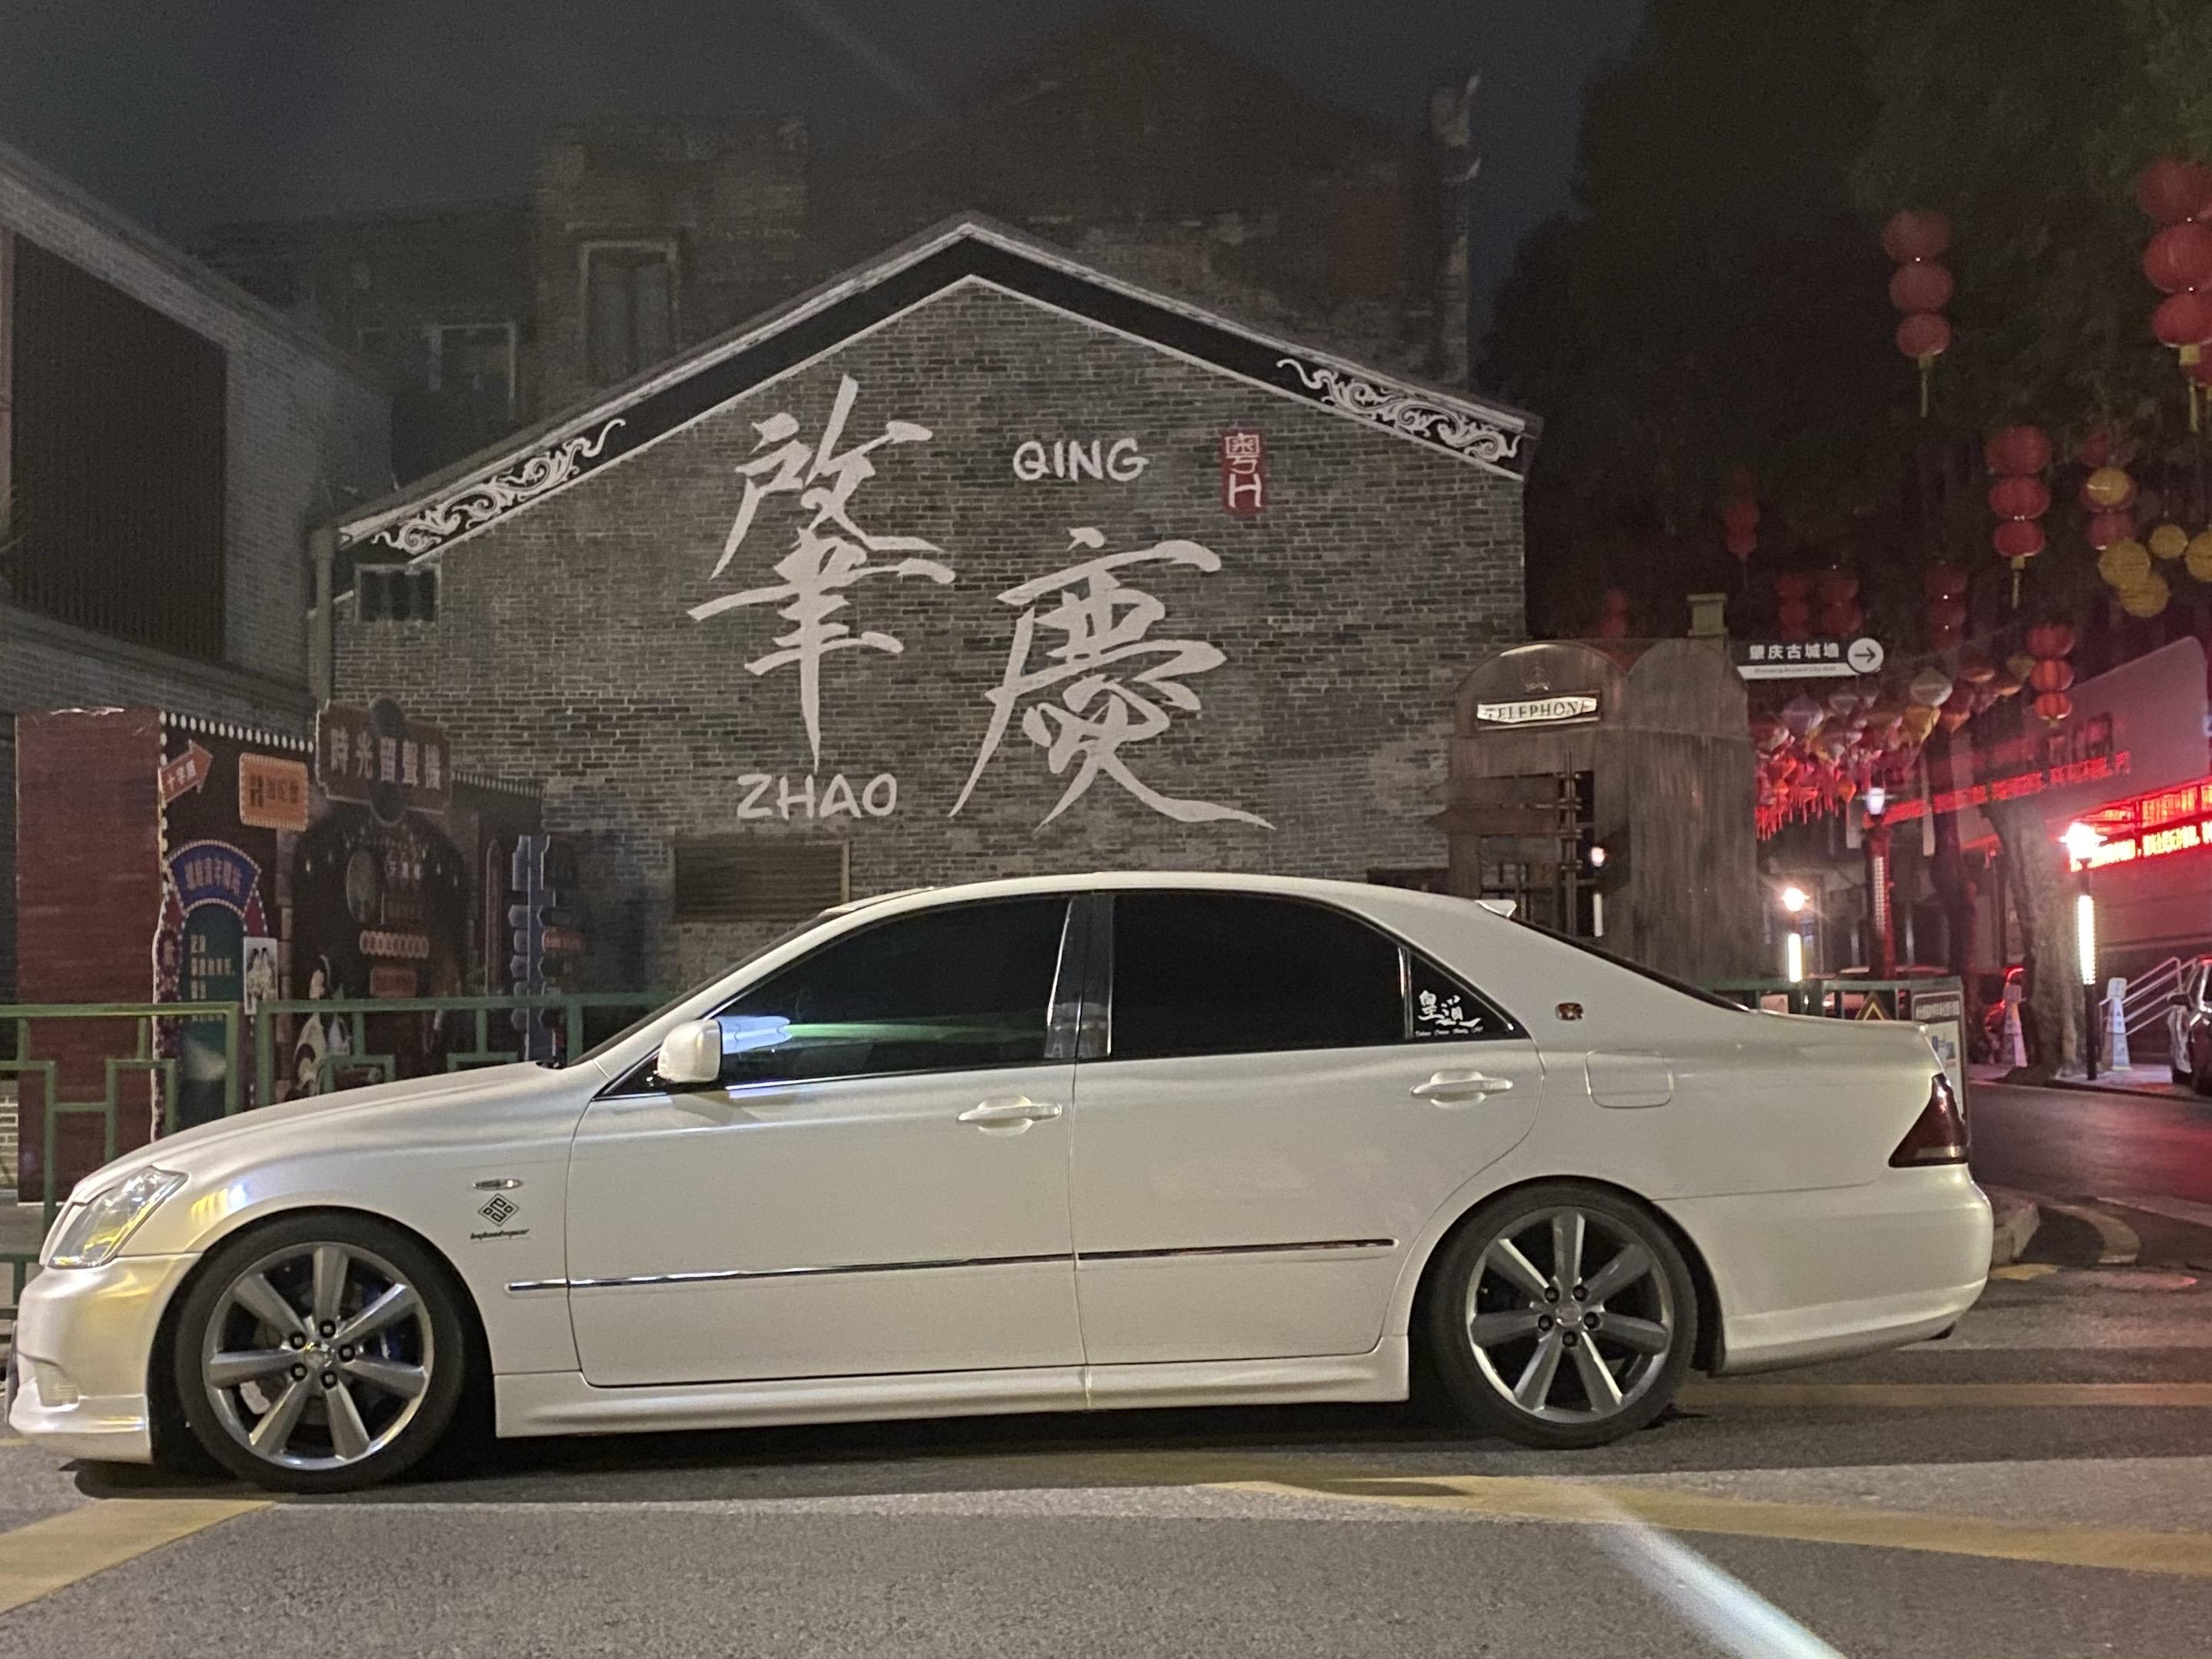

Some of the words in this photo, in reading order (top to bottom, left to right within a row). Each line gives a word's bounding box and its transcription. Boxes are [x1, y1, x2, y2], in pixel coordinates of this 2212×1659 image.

[1013, 438, 1150, 482] QING
[687, 373, 956, 775] 肇
[1749, 642, 1840, 661] 肇庆古城墙
[737, 773, 897, 820] ZHAO
